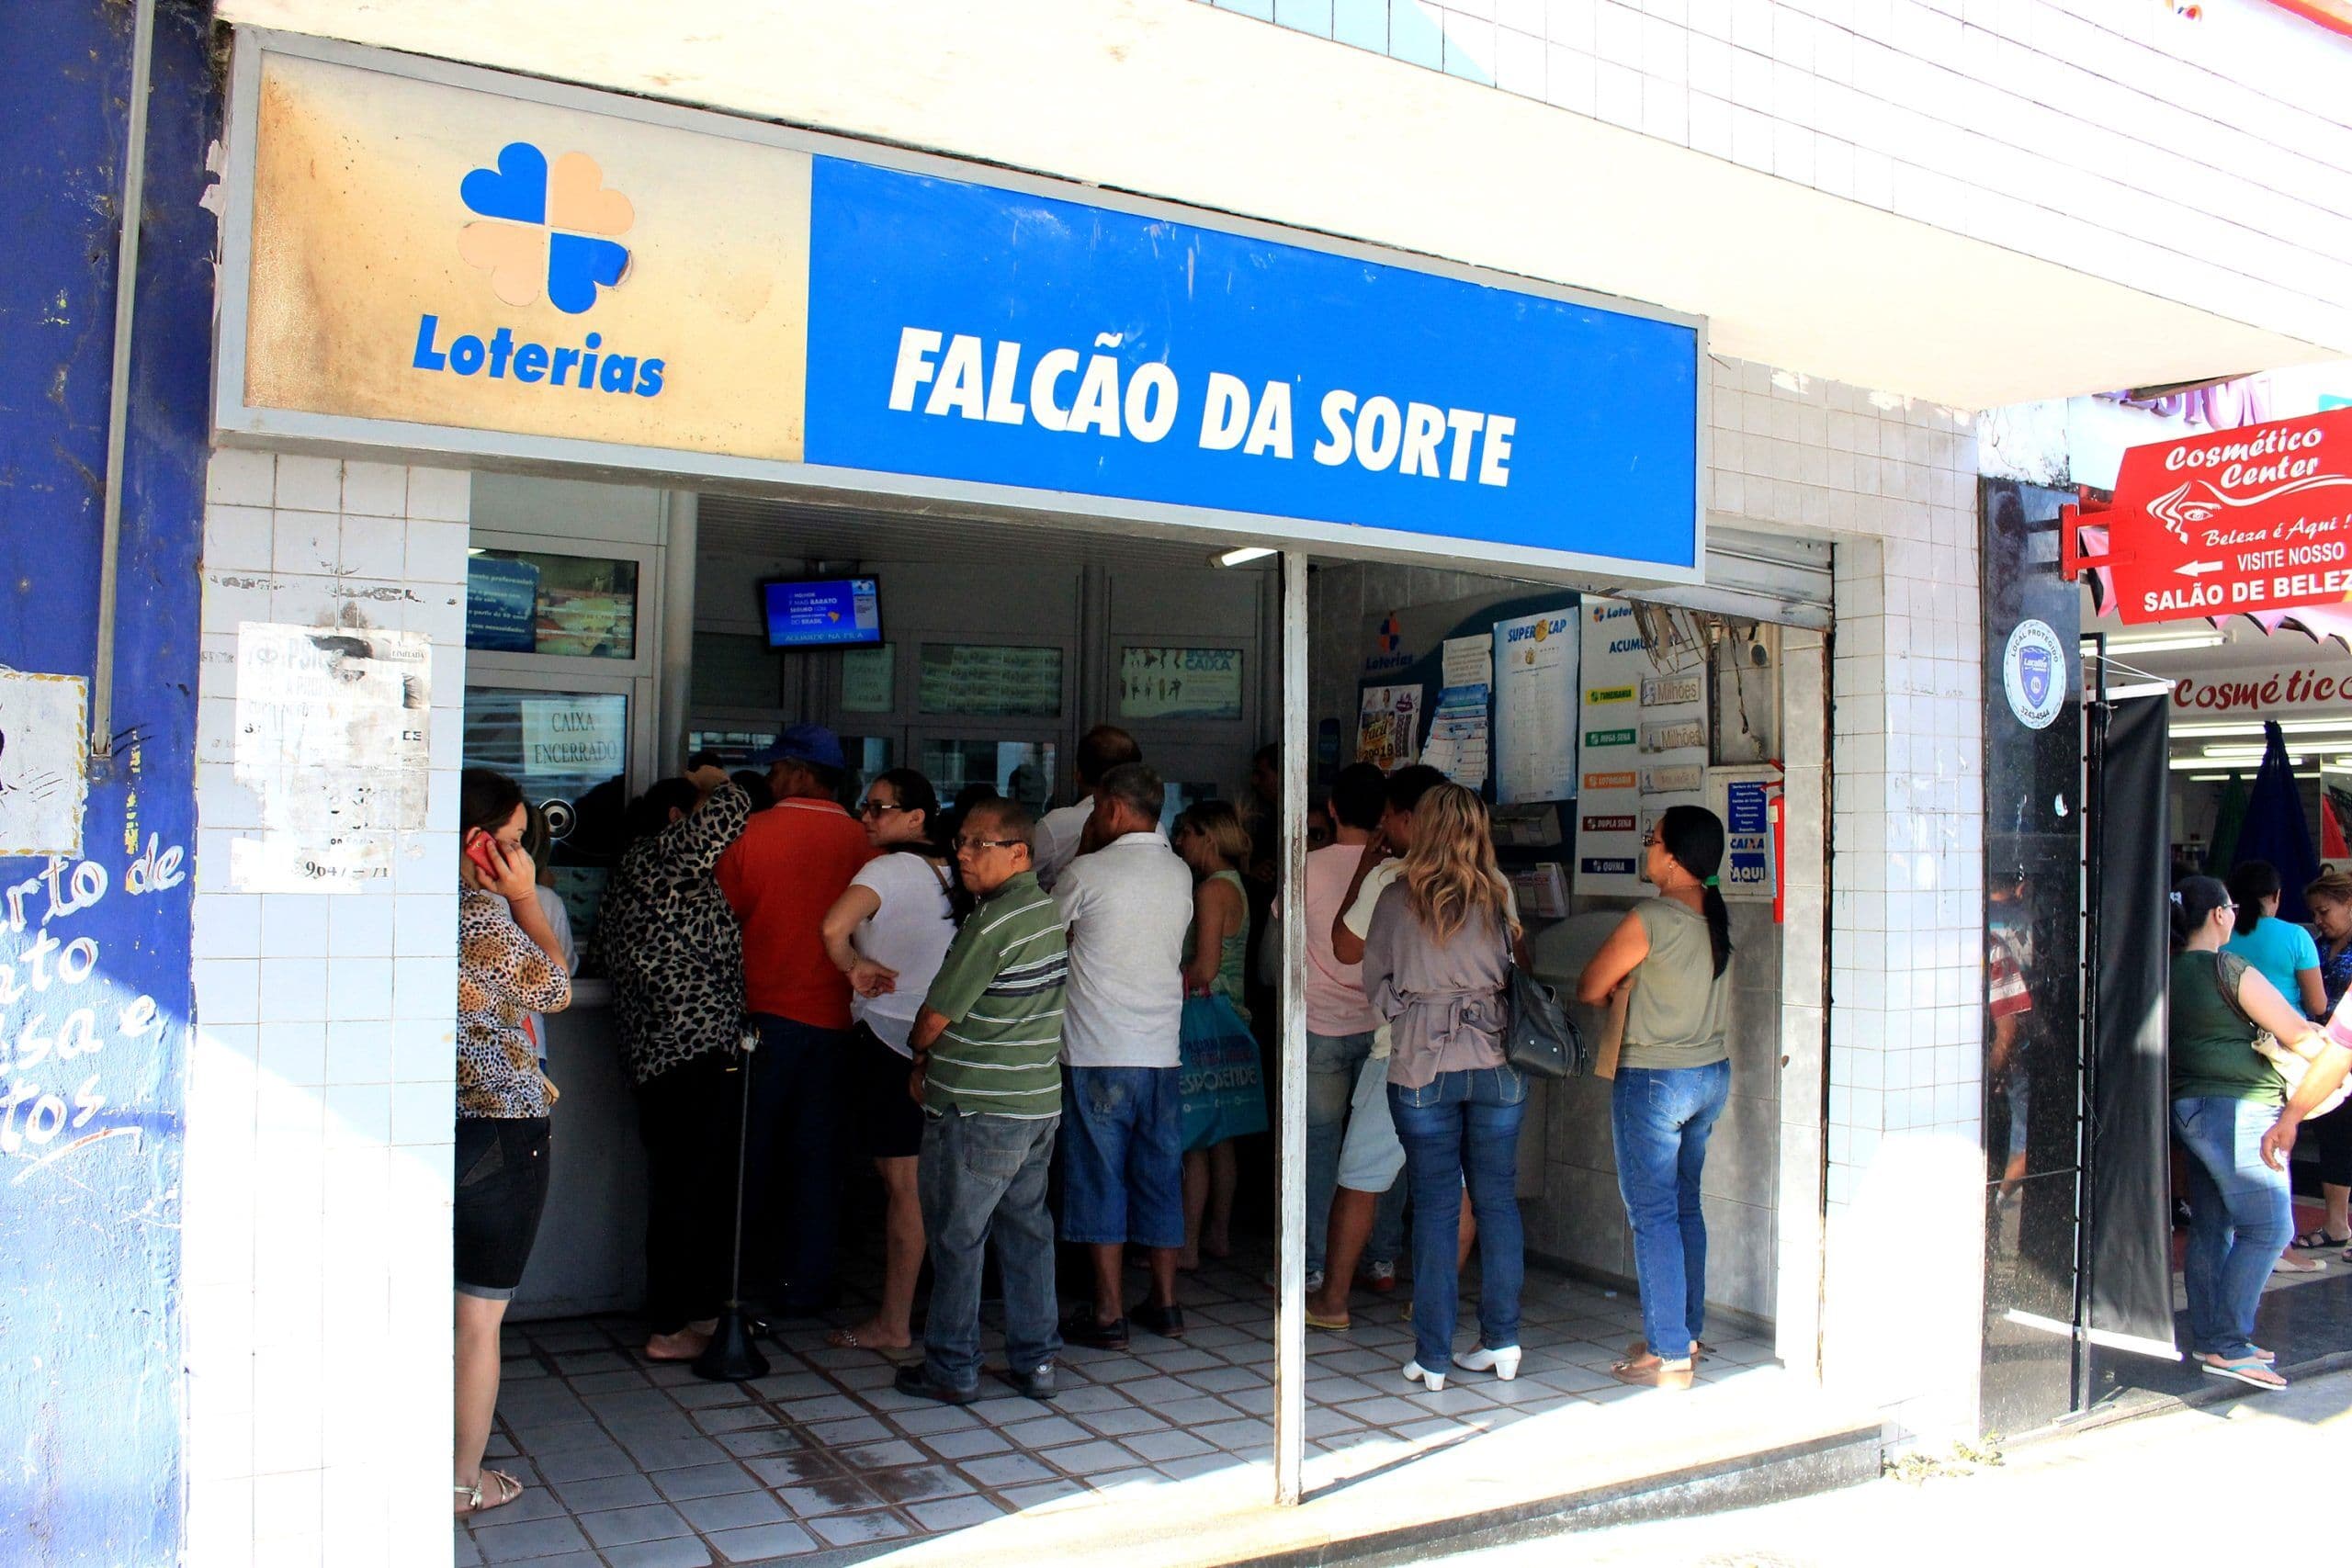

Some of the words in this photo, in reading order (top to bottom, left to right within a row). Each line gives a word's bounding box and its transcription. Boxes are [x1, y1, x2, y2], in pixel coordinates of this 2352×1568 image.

[413, 314, 665, 398] Loterias
[888, 326, 1180, 444] FALCÃO
[1199, 372, 1294, 459] DA
[1314, 389, 1517, 488] SORTE
[2165, 427, 2324, 471] Cosmético
[2220, 456, 2319, 489] Center
[2201, 530, 2267, 547] Beleza
[2284, 514, 2337, 541] Aqui
[2237, 549, 2284, 572] VISITE
[2289, 541, 2345, 566] NOSSO
[2143, 581, 2224, 613] SALÃO
[2232, 580, 2265, 603] DE
[1508, 626, 1536, 643] SUPER
[1548, 618, 1567, 635] CAP
[2011, 631, 2028, 658] LOCAL
[2027, 628, 2059, 663] PROTEGIDO
[1185, 659, 1231, 671] CAIXA
[1365, 652, 1414, 671] Loterias
[1657, 681, 1697, 700] Milhões
[551, 712, 595, 733] CAIXA
[534, 740, 617, 764] ENCERRADO
[1661, 727, 1702, 749] Milhões
[1730, 837, 1764, 850] CAIXA
[1602, 861, 1625, 872] QUINA
[1733, 866, 1765, 880] AQUI
[0, 853, 108, 932] rto
[125, 831, 186, 897] de
[0, 1007, 105, 1077] sa
